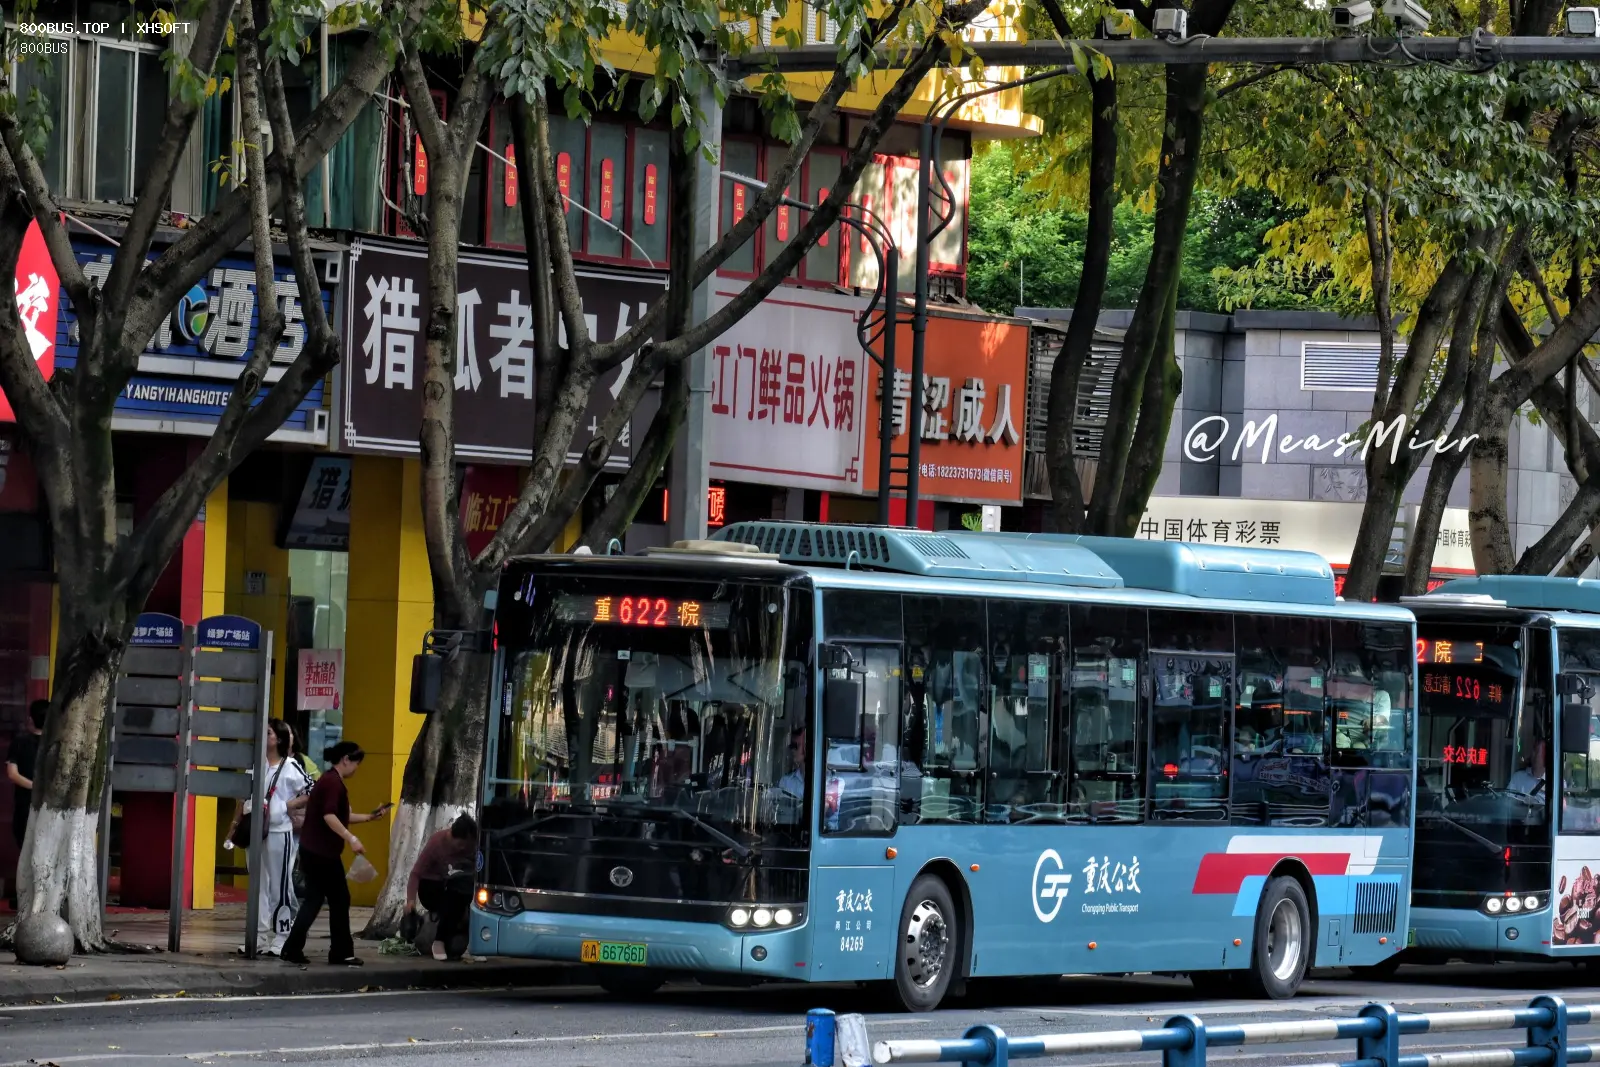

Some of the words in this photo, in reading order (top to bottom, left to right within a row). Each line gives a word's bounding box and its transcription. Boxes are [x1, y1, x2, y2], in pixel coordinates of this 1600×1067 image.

[126, 383, 232, 407] YANGYIHANGHOTE
[1140, 517, 1281, 544] 中国体育彩票
[594, 596, 611, 622] 重
[619, 597, 668, 626] 622
[1434, 641, 1452, 663] 院
[1082, 855, 1142, 895] 重庆公交
[836, 888, 874, 913] 重庆公交
[1106, 903, 1119, 913] Public
[1119, 903, 1139, 915] Transport
[279, 919, 290, 933] M
[602, 945, 645, 962] 66766D
[840, 935, 864, 952] 84269
